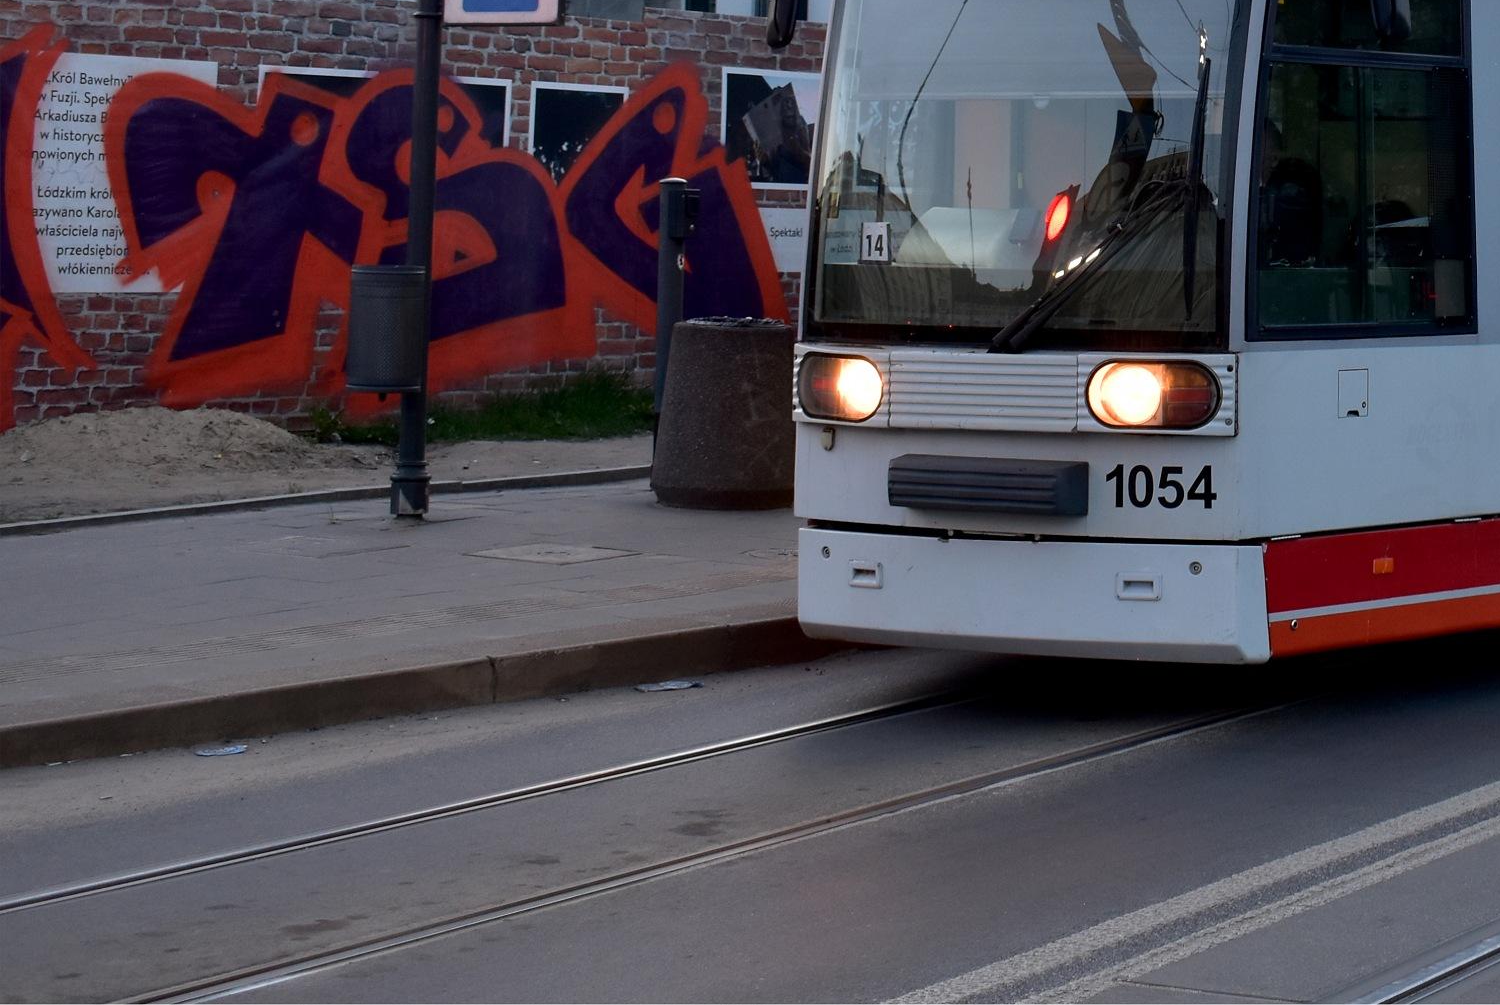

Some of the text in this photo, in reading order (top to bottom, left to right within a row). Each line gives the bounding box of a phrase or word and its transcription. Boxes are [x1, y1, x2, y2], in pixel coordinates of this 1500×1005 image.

[50, 90, 81, 107] Fuzji.
[53, 129, 105, 145] historycz
[32, 148, 95, 164] nowionych
[37, 186, 87, 199] Łódzkim
[32, 207, 83, 222] azywano
[56, 244, 129, 258] przedsiębior
[866, 234, 884, 256] 14
[1105, 463, 1217, 510] 1054
